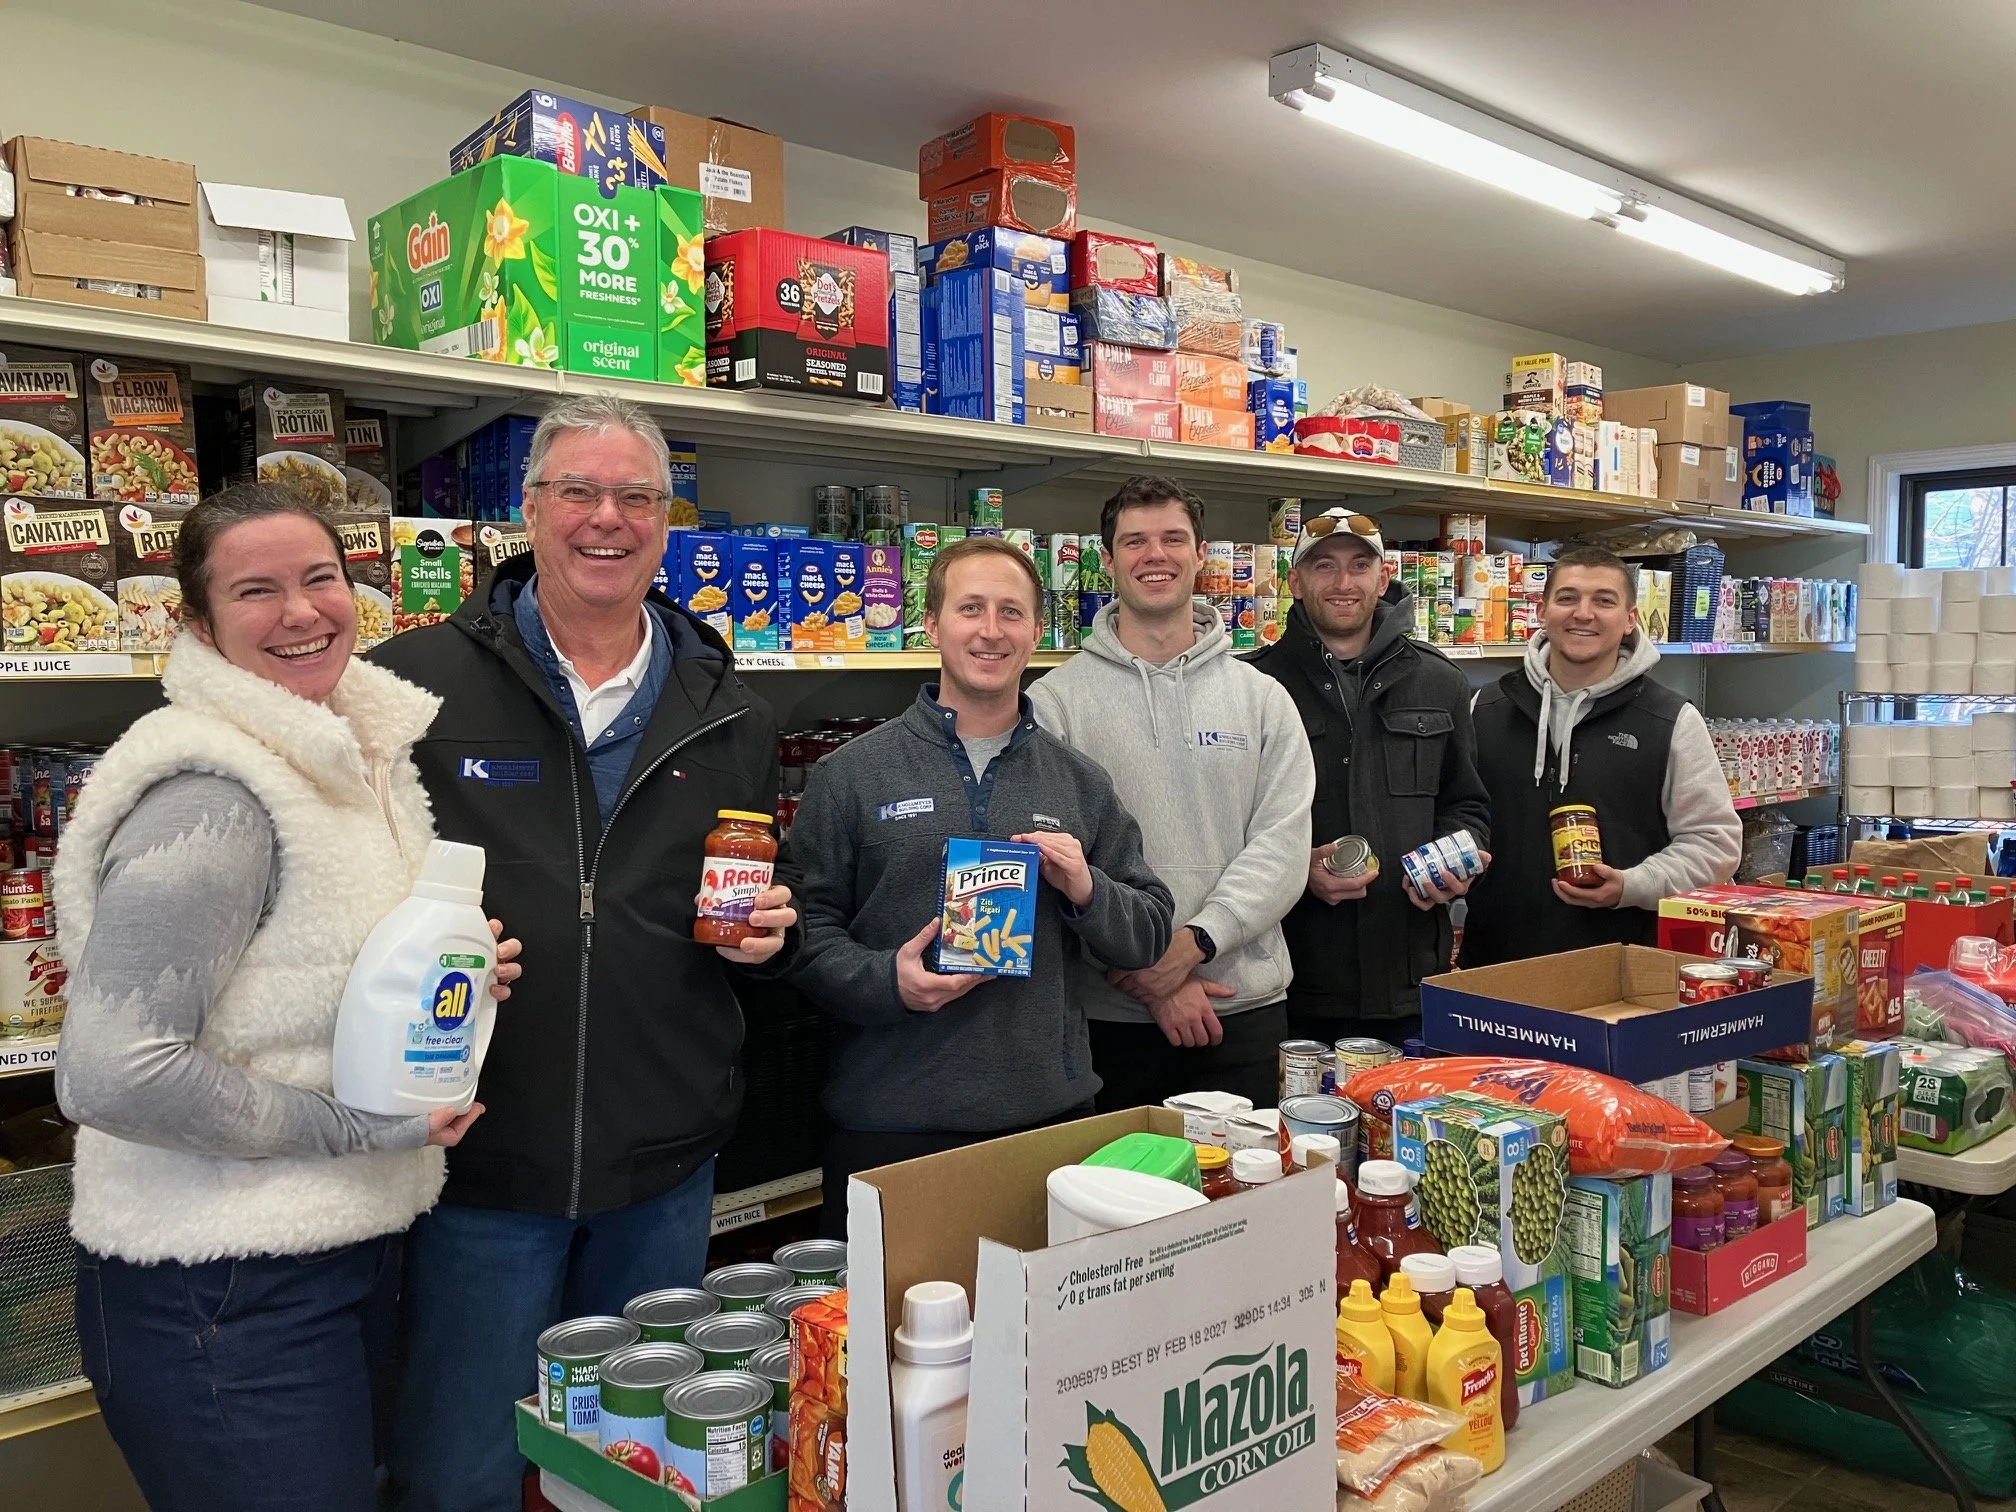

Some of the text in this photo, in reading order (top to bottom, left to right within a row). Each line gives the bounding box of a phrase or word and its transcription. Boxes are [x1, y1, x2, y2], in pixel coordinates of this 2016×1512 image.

[536, 94, 555, 108] 6
[574, 203, 619, 231] OXI
[408, 212, 450, 272] Gain
[579, 268, 637, 293] MORE
[421, 285, 441, 308] OXI
[780, 283, 800, 302] 36
[583, 340, 640, 360] original
[806, 346, 847, 361] ORIGINAL
[592, 355, 631, 371] scent
[805, 359, 846, 371] SEASONED
[1152, 359, 1168, 372] BEEF
[114, 381, 168, 397] ELBOW
[1149, 372, 1171, 387] FLAVOR
[112, 397, 179, 415] MACARONI
[277, 414, 328, 434] ROTINI
[1154, 412, 1169, 426] BEEF
[11, 519, 102, 545] CAVATAPPI
[410, 566, 452, 580] Shells
[419, 559, 442, 568] Small
[33, 659, 71, 672] JUICE
[959, 867, 1020, 890] Prince
[980, 898, 994, 907] Ziti
[980, 905, 1001, 916] Rigati
[1686, 906, 1709, 917] 50%
[436, 982, 467, 1018] all
[1888, 996, 1901, 1016] 45
[1453, 1013, 1577, 1052] HAMMERMILL
[1680, 1013, 1764, 1046] HAMMERMILL
[1918, 1077, 1937, 1090] 28
[1401, 1148, 1415, 1162] 8
[1507, 1142, 1520, 1157] 8
[716, 1209, 761, 1228] WHITE RICE
[1070, 1256, 1144, 1286] Cholesterol Free
[1070, 1262, 1175, 1305] 0 g trans fat per serving
[1518, 1303, 1529, 1353] Monte
[1111, 1350, 1144, 1375] BEST
[1146, 1345, 1161, 1364] BY
[1164, 1336, 1187, 1357] FEB
[1189, 1330, 1201, 1349] 18
[1203, 1319, 1228, 1343] 2027
[1161, 1342, 1309, 1478] Mazola
[708, 1422, 747, 1435] Nutrition Facts
[708, 1446, 730, 1455] Calories
[1199, 1423, 1312, 1494] CORN OIL
[827, 1440, 844, 1491] YAMS
